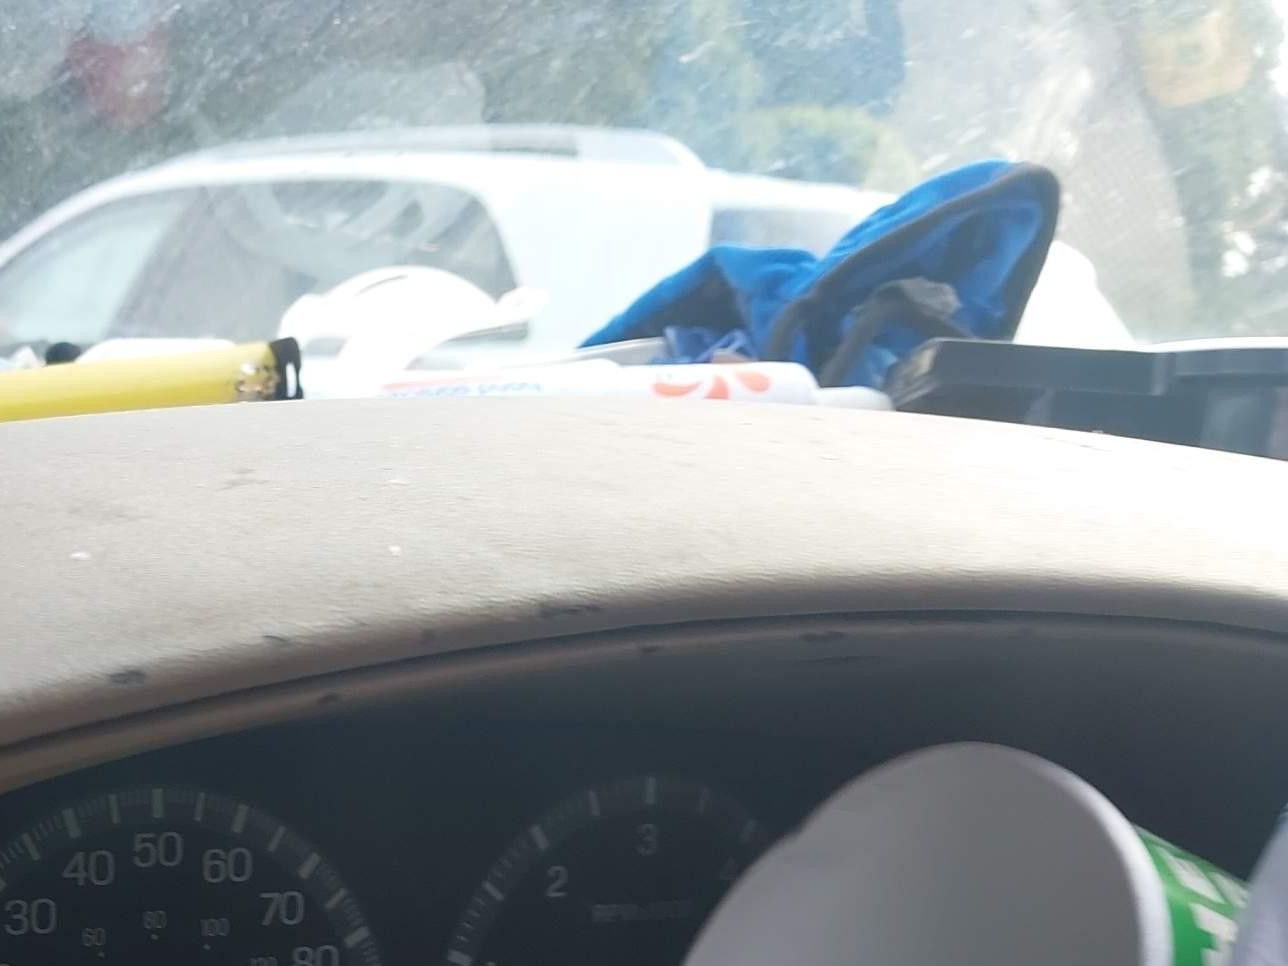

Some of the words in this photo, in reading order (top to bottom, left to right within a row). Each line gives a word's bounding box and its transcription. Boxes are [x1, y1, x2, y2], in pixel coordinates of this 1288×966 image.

[133, 832, 183, 867] 50
[637, 823, 659, 856] 3
[63, 850, 114, 885] 40
[203, 847, 252, 882] 60
[546, 865, 568, 898] 2
[4, 899, 57, 935] 30
[260, 891, 304, 926] 70
